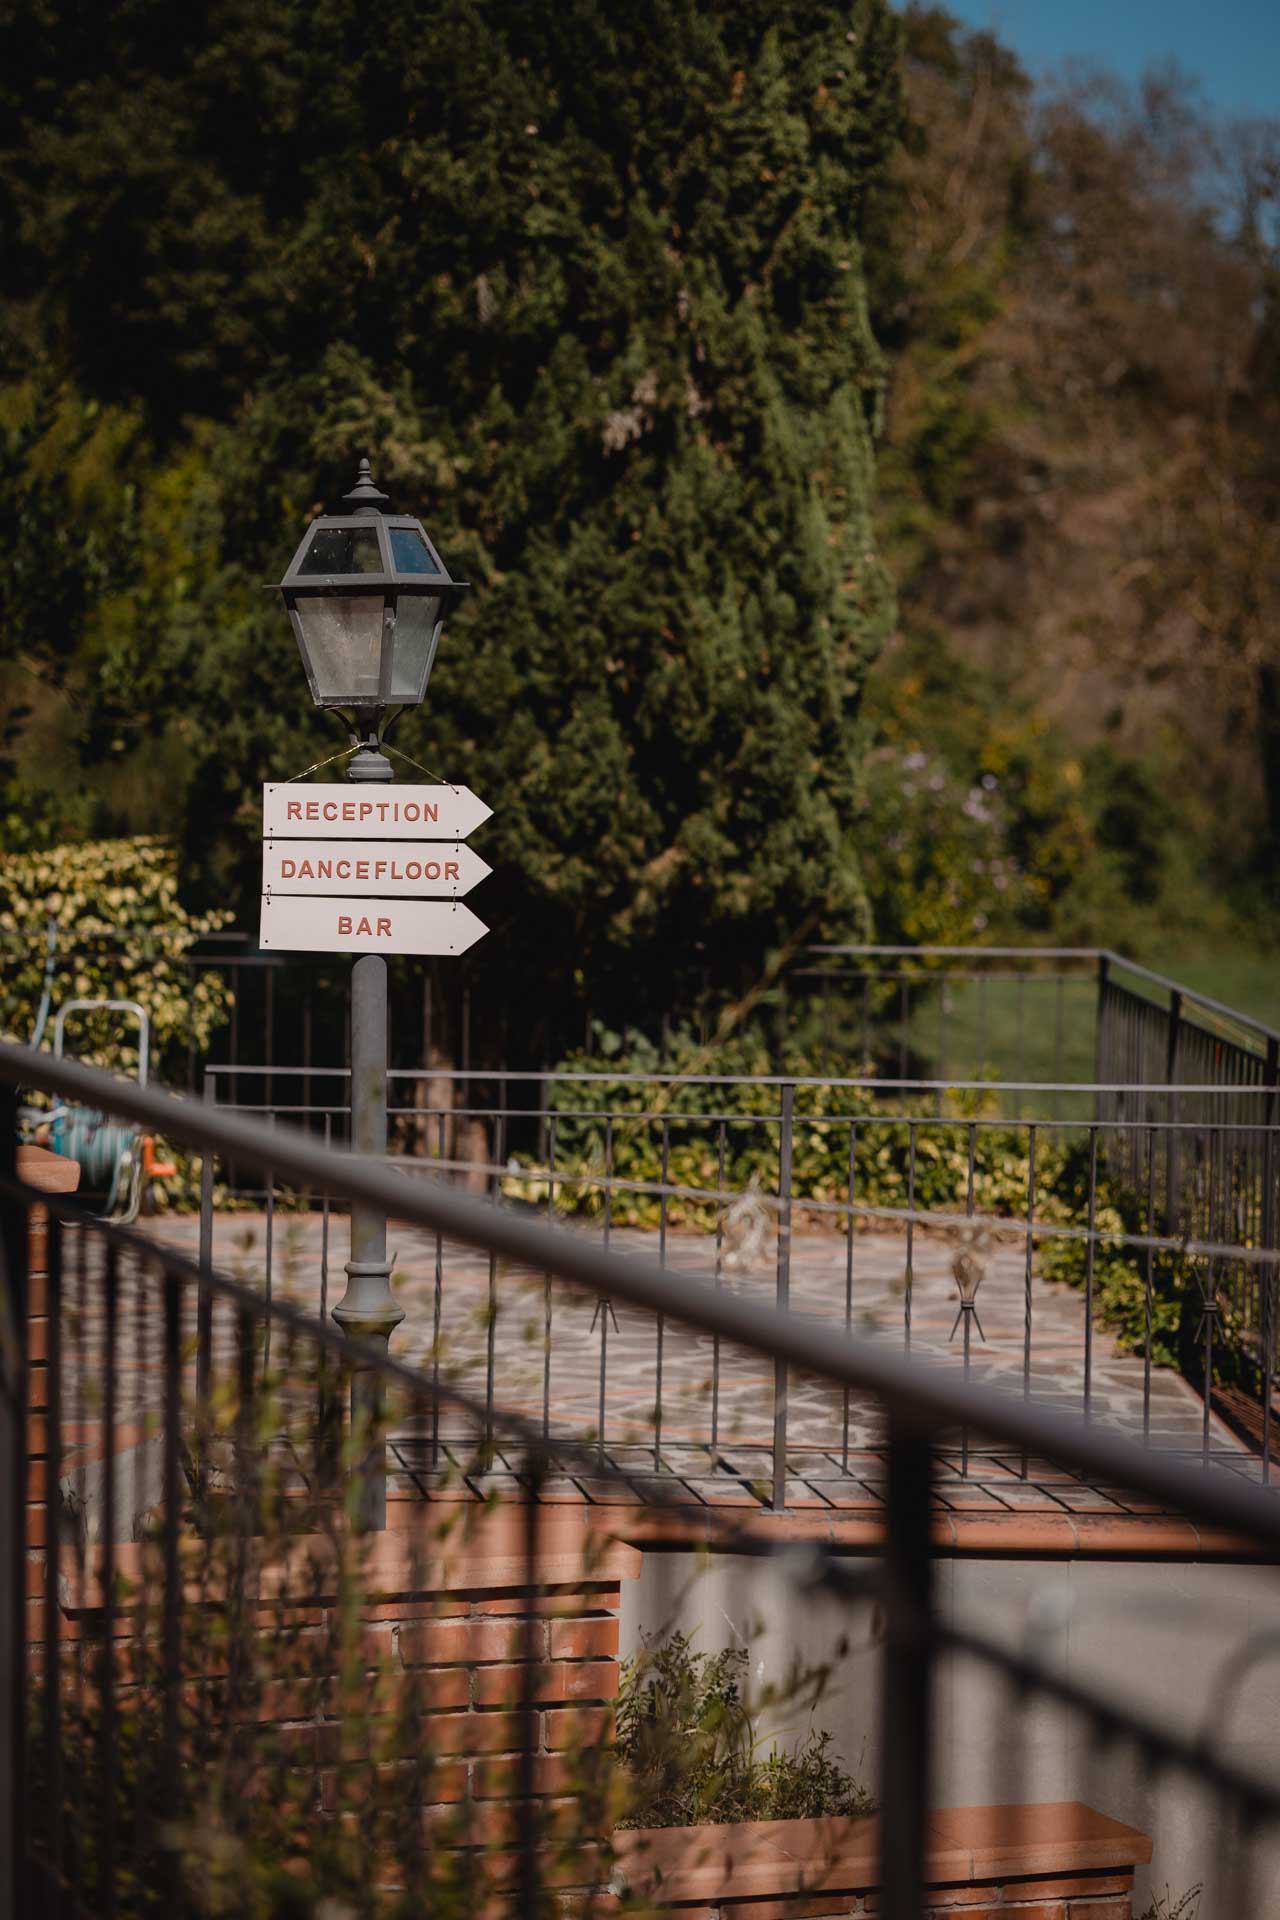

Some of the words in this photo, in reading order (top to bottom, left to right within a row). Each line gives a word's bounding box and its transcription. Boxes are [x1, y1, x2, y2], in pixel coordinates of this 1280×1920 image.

[287, 801, 438, 822] RECEPTION
[281, 859, 460, 881] DANCEFLOOR
[338, 916, 392, 937] BAR
